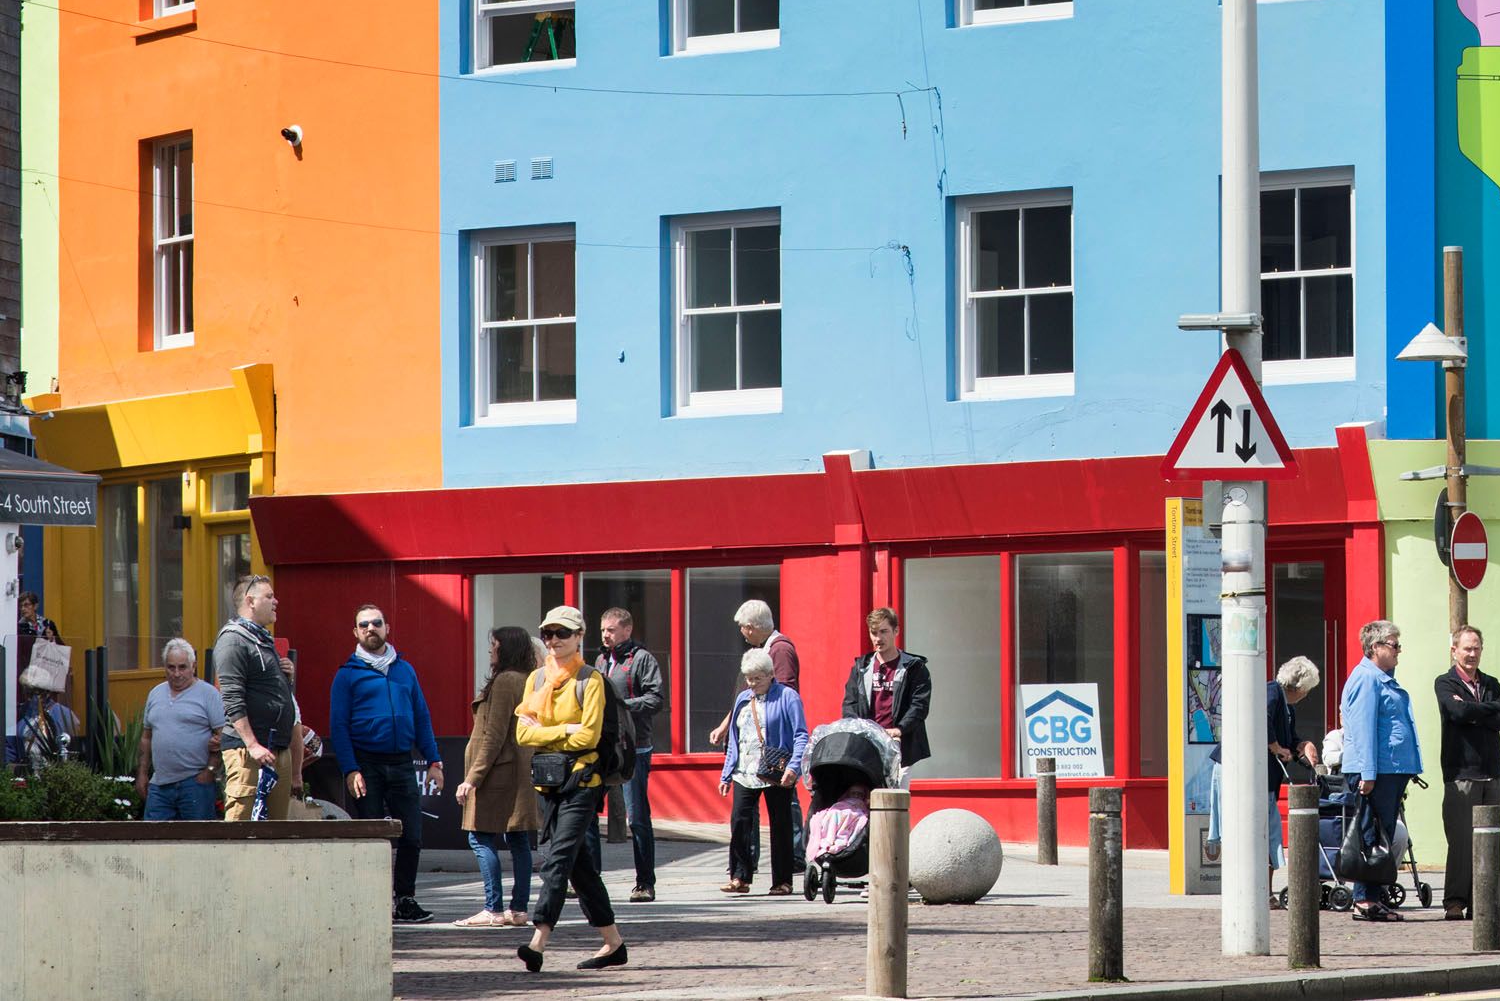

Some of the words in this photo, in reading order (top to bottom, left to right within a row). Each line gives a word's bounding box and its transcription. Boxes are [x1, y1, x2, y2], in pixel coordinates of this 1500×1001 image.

[14, 493, 52, 515] South
[52, 495, 92, 516] Street
[1028, 715, 1092, 744] CBG
[1027, 746, 1097, 757] CONSTRUCTION
